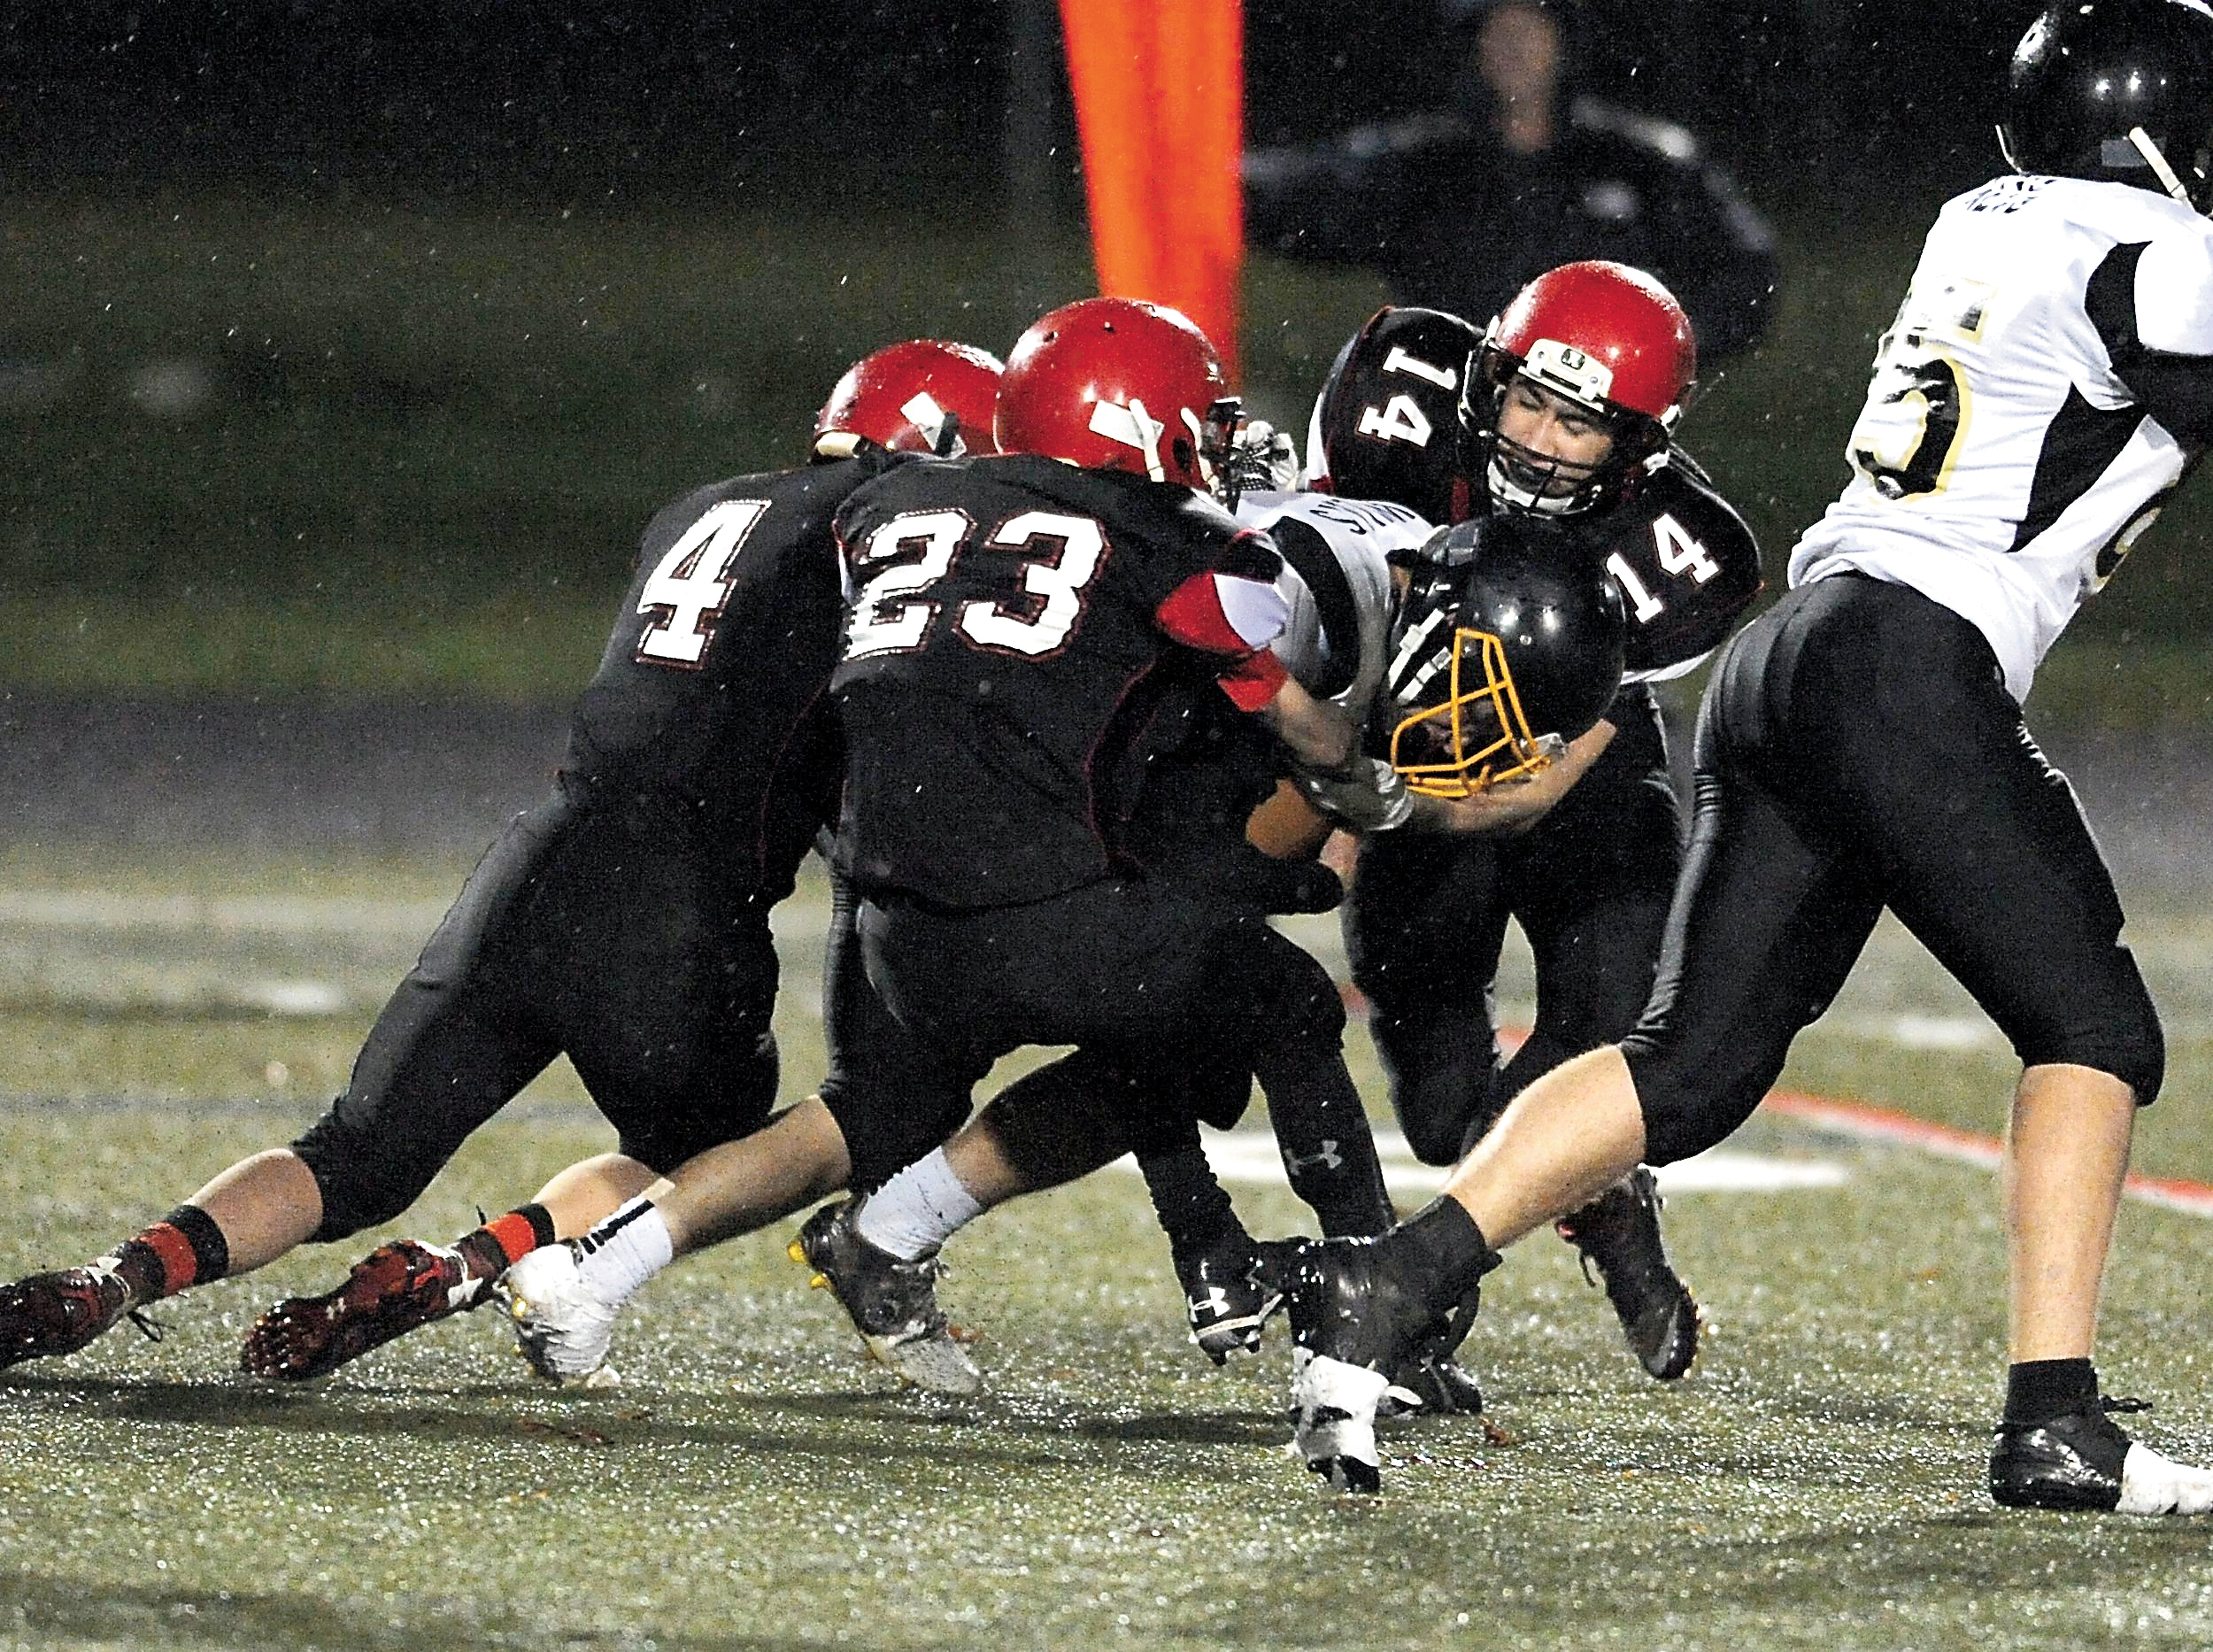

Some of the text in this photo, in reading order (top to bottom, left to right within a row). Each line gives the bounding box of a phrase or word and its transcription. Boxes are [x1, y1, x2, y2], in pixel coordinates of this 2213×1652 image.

[1354, 345, 1458, 449] 14
[635, 498, 773, 670] 4
[842, 507, 1114, 664] 23
[1605, 512, 1722, 624] 14
